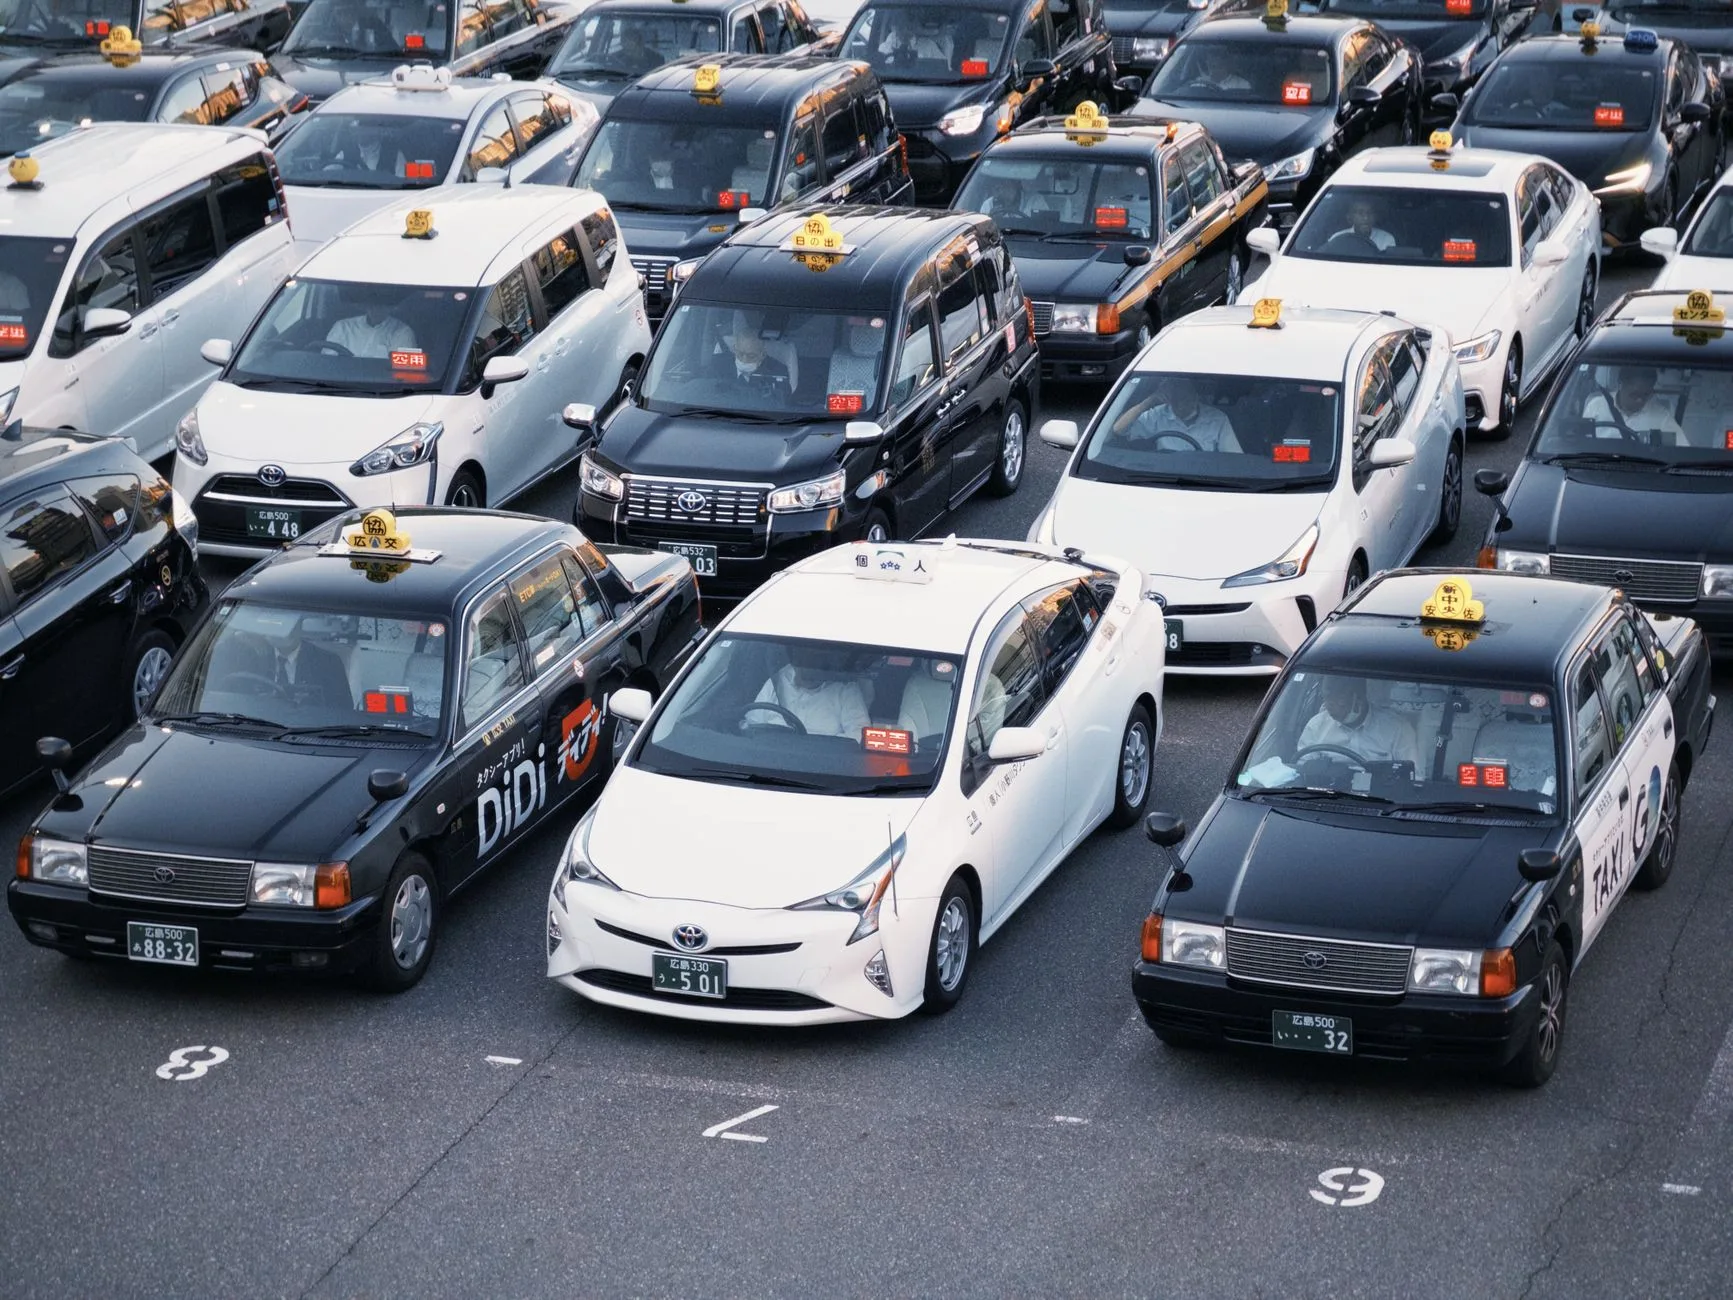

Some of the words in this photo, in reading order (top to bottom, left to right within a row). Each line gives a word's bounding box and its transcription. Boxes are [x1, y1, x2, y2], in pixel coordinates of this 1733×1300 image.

[796, 235, 834, 248] 日の出
[1677, 309, 1719, 320] センター
[365, 519, 384, 535] 協
[477, 742, 547, 859] DiDi
[1593, 831, 1624, 917] TAXI
[143, 938, 196, 963] 88-32
[156, 1045, 229, 1081] 8
